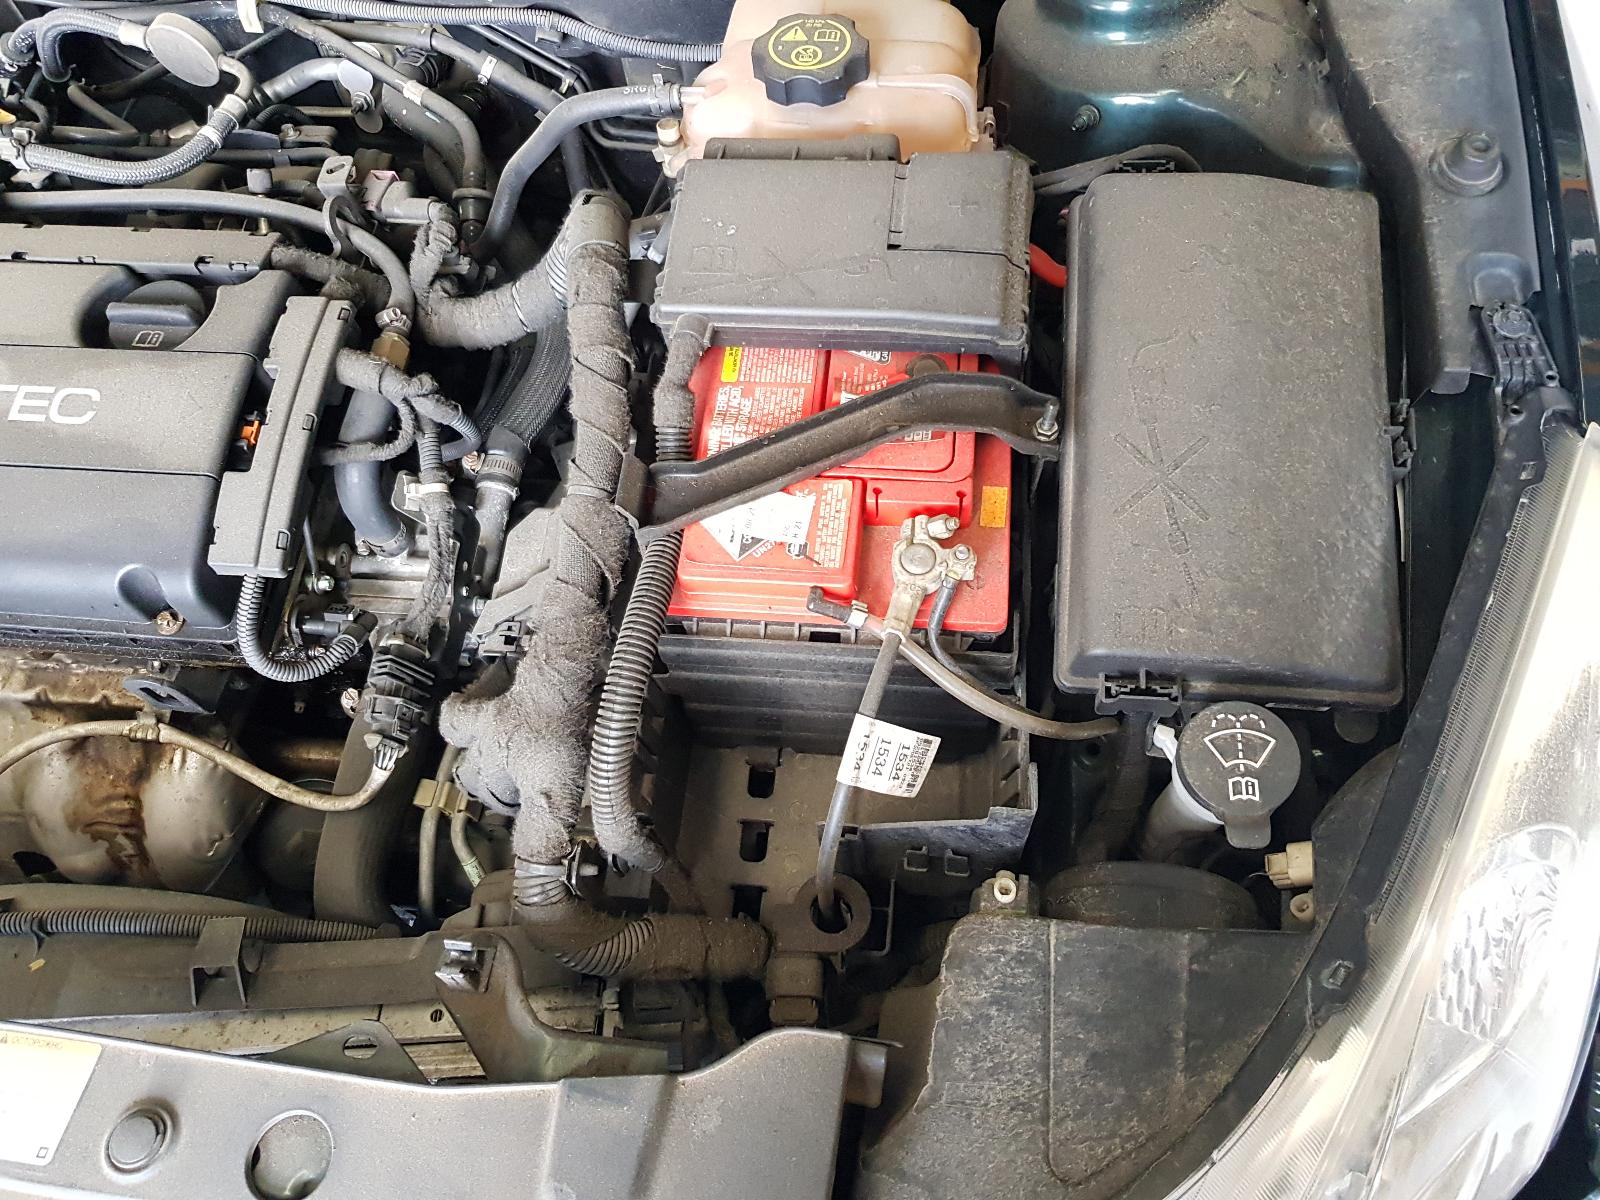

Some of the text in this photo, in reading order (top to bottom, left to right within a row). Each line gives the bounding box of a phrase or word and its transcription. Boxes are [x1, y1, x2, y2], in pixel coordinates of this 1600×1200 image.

[727, 385, 744, 407] ACID,
[734, 396, 753, 432] STORAGE
[724, 408, 739, 423] WITH
[871, 737, 892, 777] 1534
[892, 743, 911, 782] 1534
